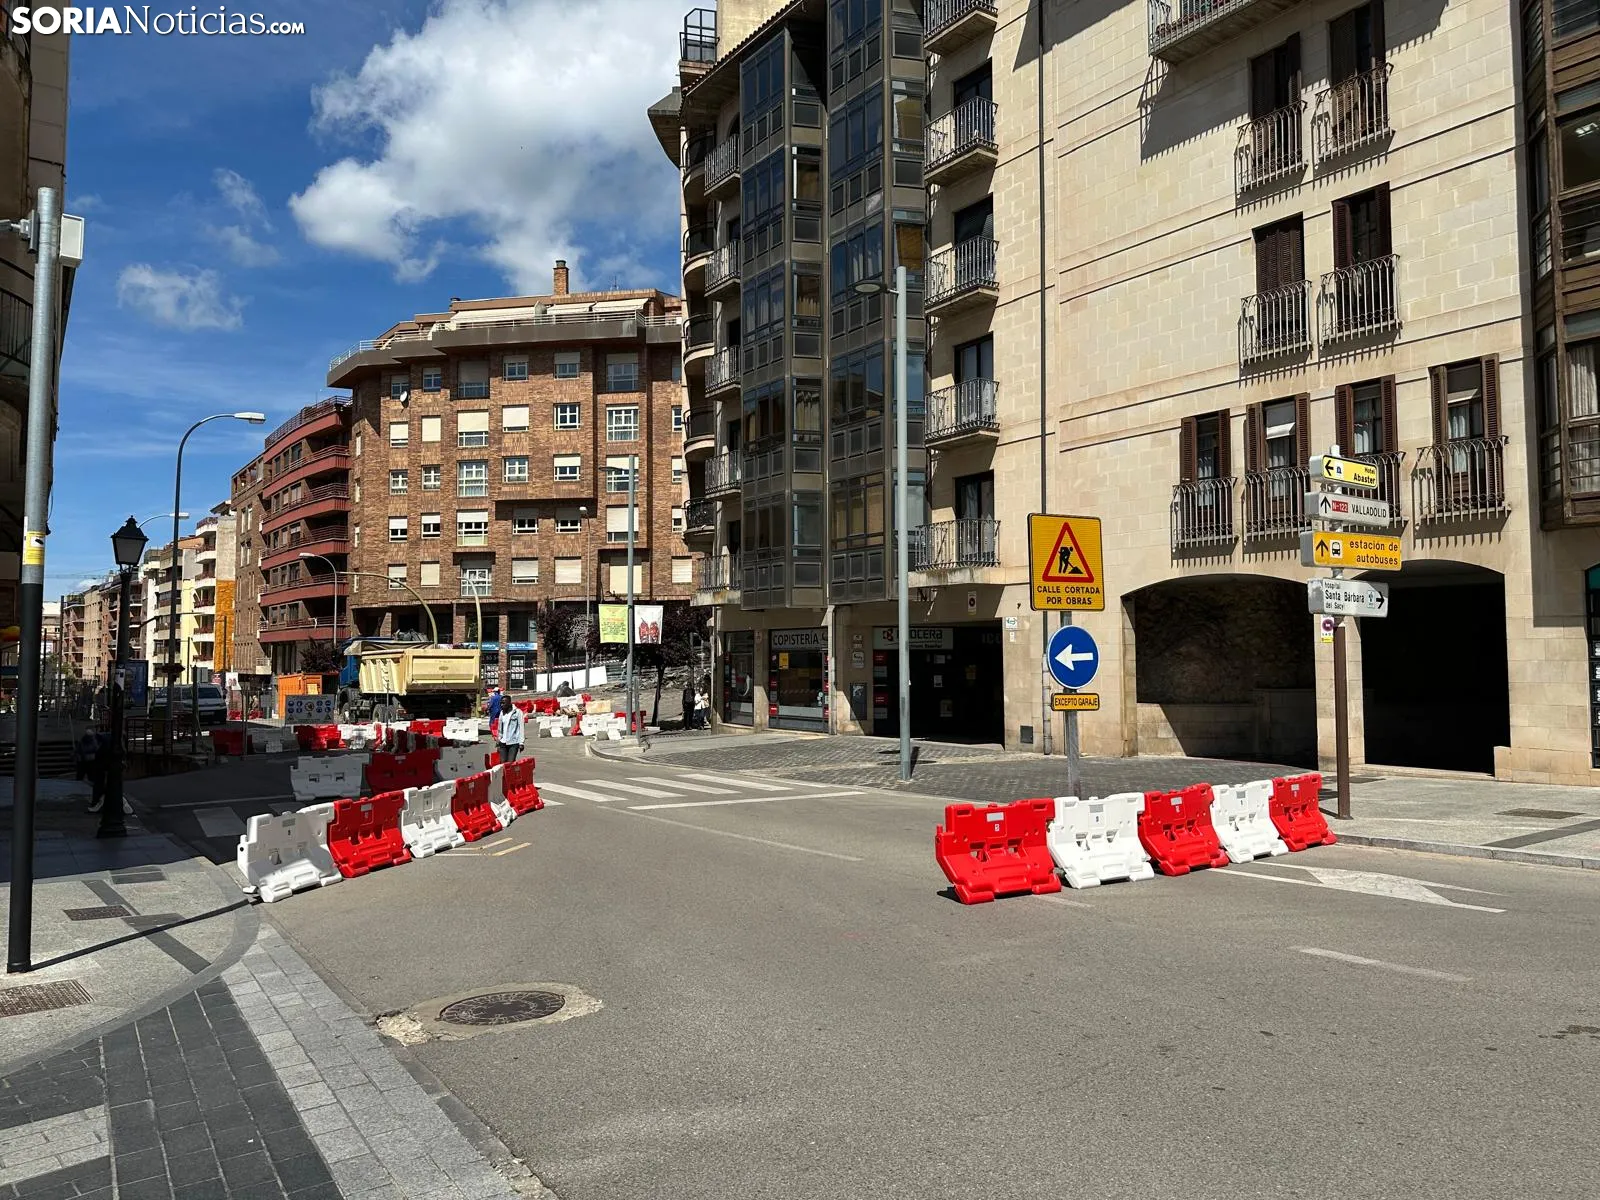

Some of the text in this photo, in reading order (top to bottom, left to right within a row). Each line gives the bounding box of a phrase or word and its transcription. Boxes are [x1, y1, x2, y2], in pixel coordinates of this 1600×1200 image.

[1364, 467, 1376, 475] Hotel
[1353, 473, 1376, 484] Abaster
[1332, 501, 1387, 518] N-122 VALLADOLID
[1349, 540, 1399, 552] estación de
[1356, 554, 1398, 565] autobuses
[1036, 585, 1100, 595] CALLE CORTADA
[1046, 596, 1092, 606] POR OBRAS
[1325, 589, 1365, 603] Santa Bárbara
[773, 630, 819, 646] COPISTERÍA
[1055, 697, 1098, 706] EXCEPTO GARAJE
